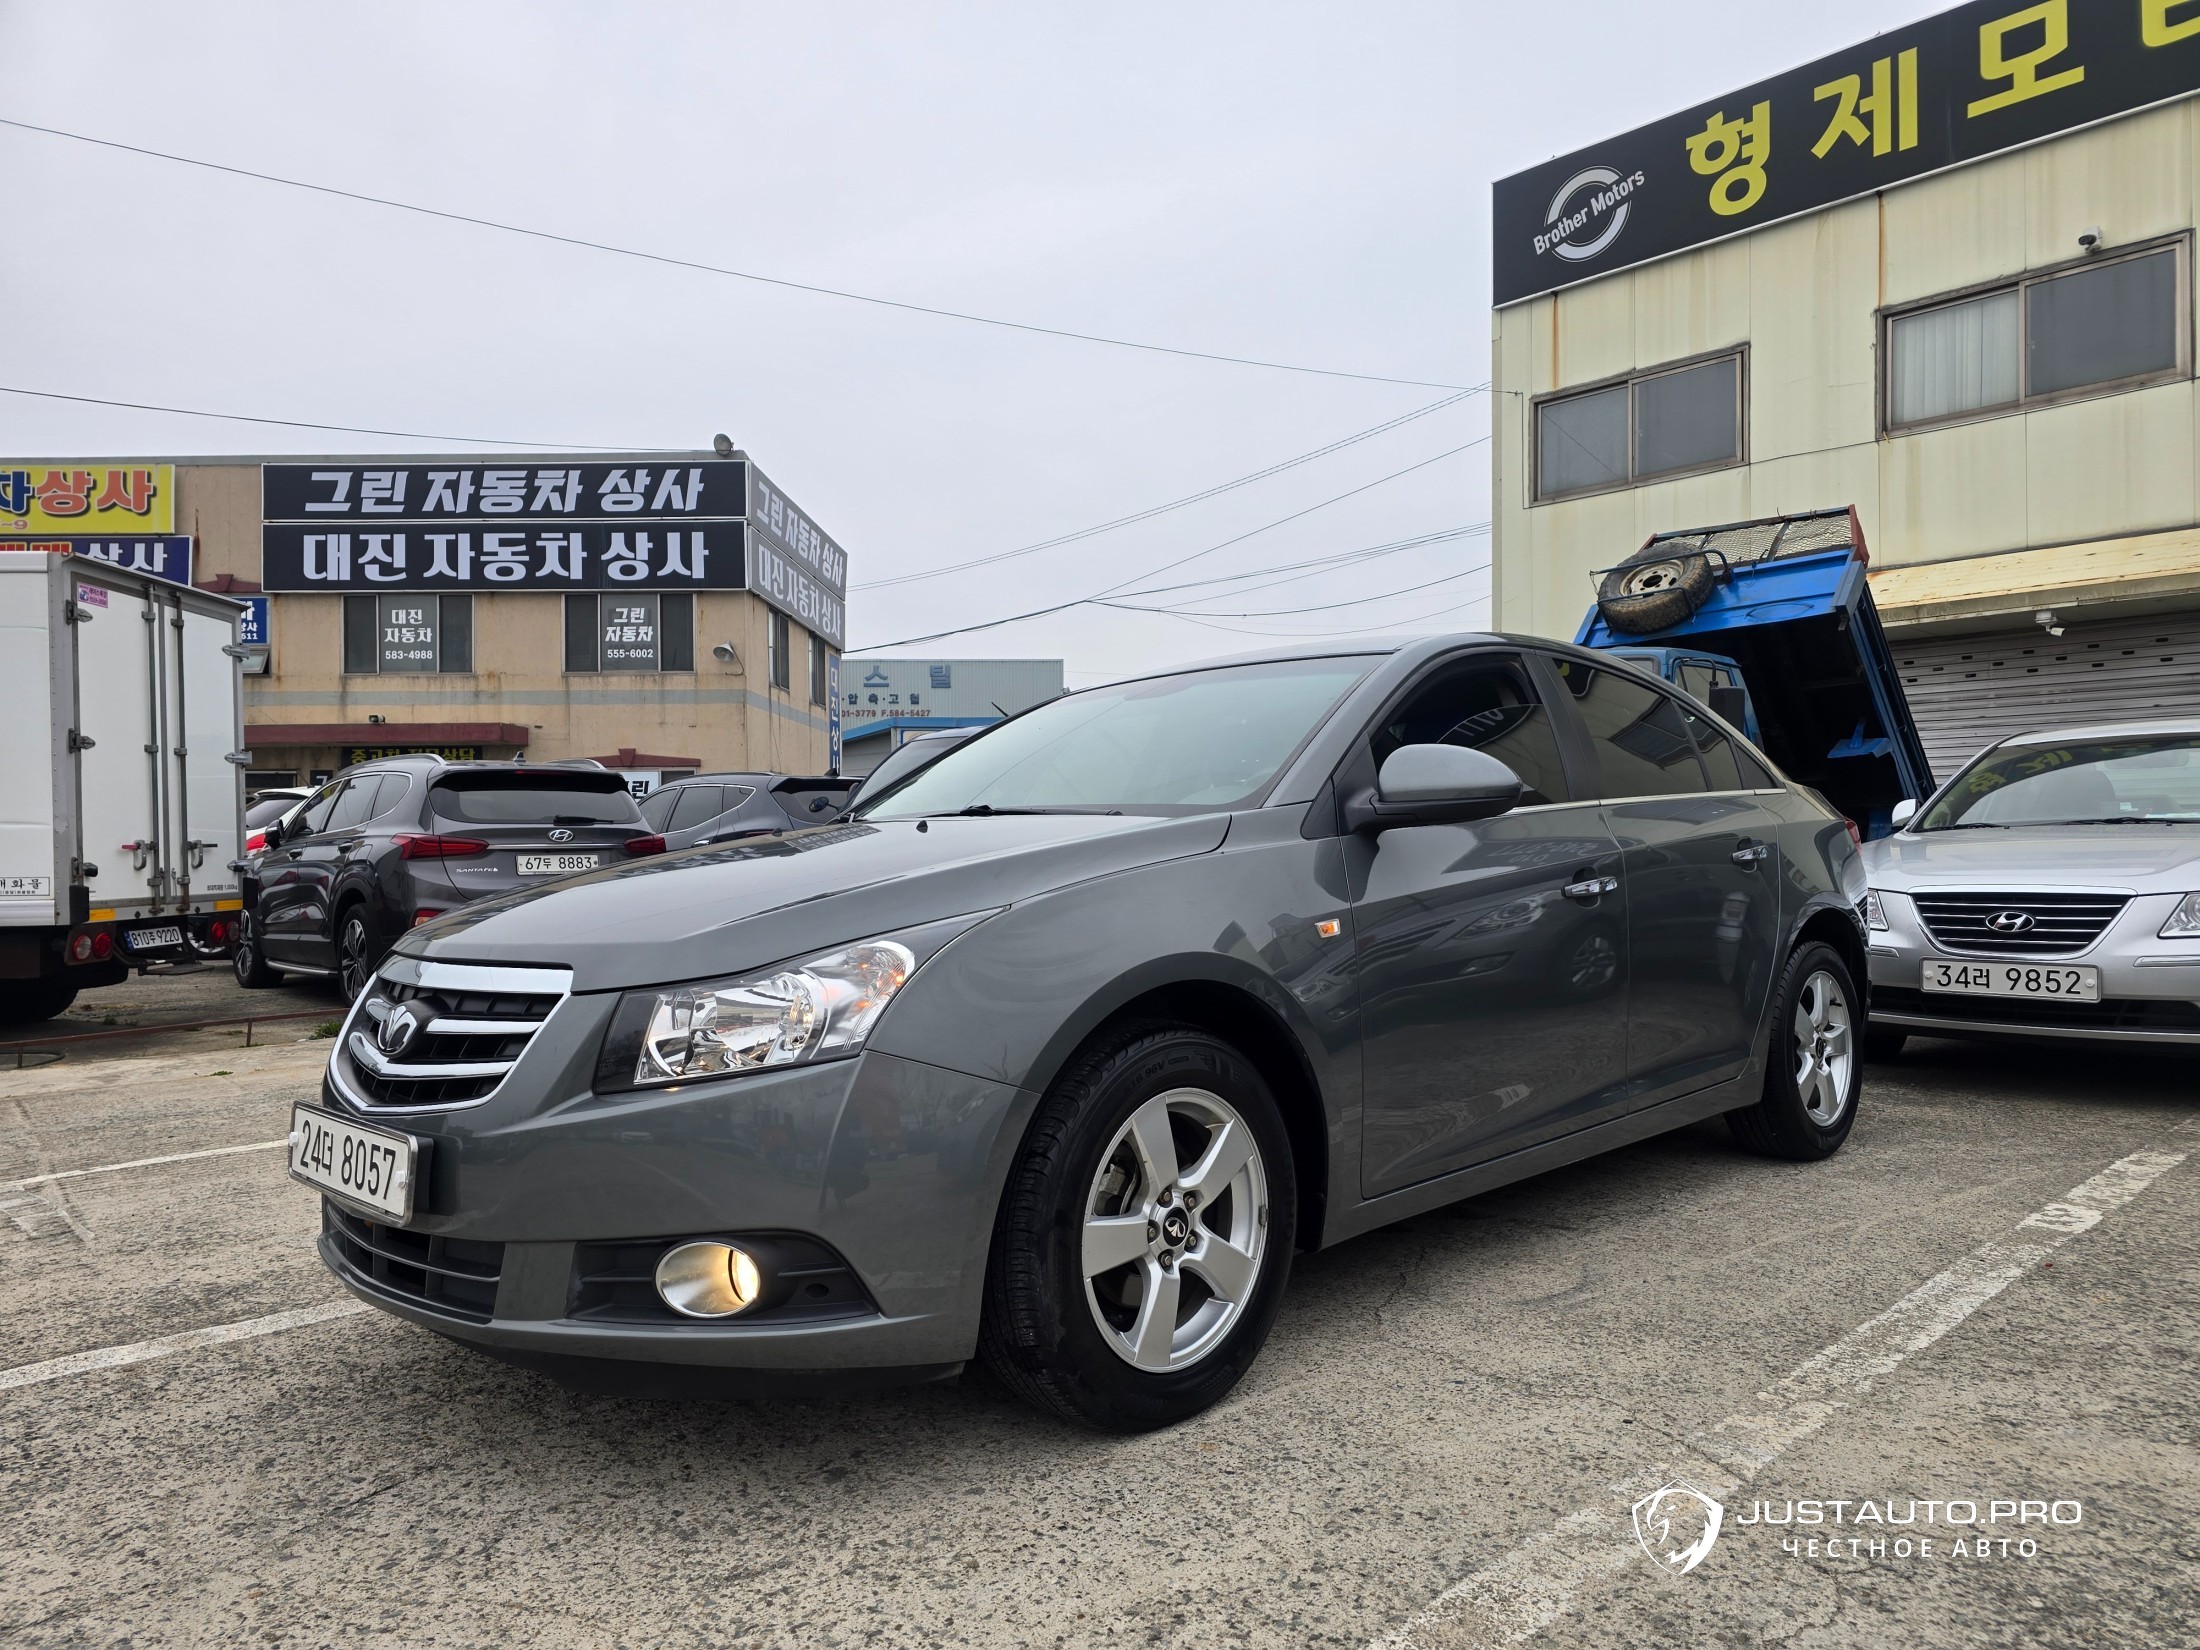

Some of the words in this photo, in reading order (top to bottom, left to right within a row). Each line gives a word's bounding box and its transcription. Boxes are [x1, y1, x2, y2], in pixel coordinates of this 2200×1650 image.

[1533, 207, 1588, 255] Brother
[1590, 170, 1645, 216] Motors
[305, 471, 409, 513] 그린
[421, 470, 583, 514] 자동차
[597, 468, 705, 512] 상사
[757, 480, 783, 538] 그린
[785, 507, 821, 569] 자동차
[823, 542, 843, 588] 상사
[303, 533, 407, 582] 대진
[423, 532, 588, 582] 자동차
[601, 531, 709, 581] 상사
[758, 543, 783, 600] 대진
[786, 566, 820, 626] 자동차
[822, 595, 841, 640] 상사
[391, 609, 423, 625] 대진
[613, 607, 646, 623] 그린
[384, 627, 433, 643] 자동차
[604, 625, 654, 642] 자동차
[385, 650, 433, 660] 583-4988
[607, 649, 654, 658] 555-6002
[881, 709, 931, 718] F.584-5427
[525, 857, 551, 870] 67두
[559, 856, 592, 869] 8883
[131, 931, 155, 946] 810주
[156, 928, 180, 943] 9220
[1937, 965, 1990, 988] 34러
[2006, 967, 2081, 994] 9852
[300, 1119, 334, 1176] 24더
[341, 1134, 396, 1200] 8057
